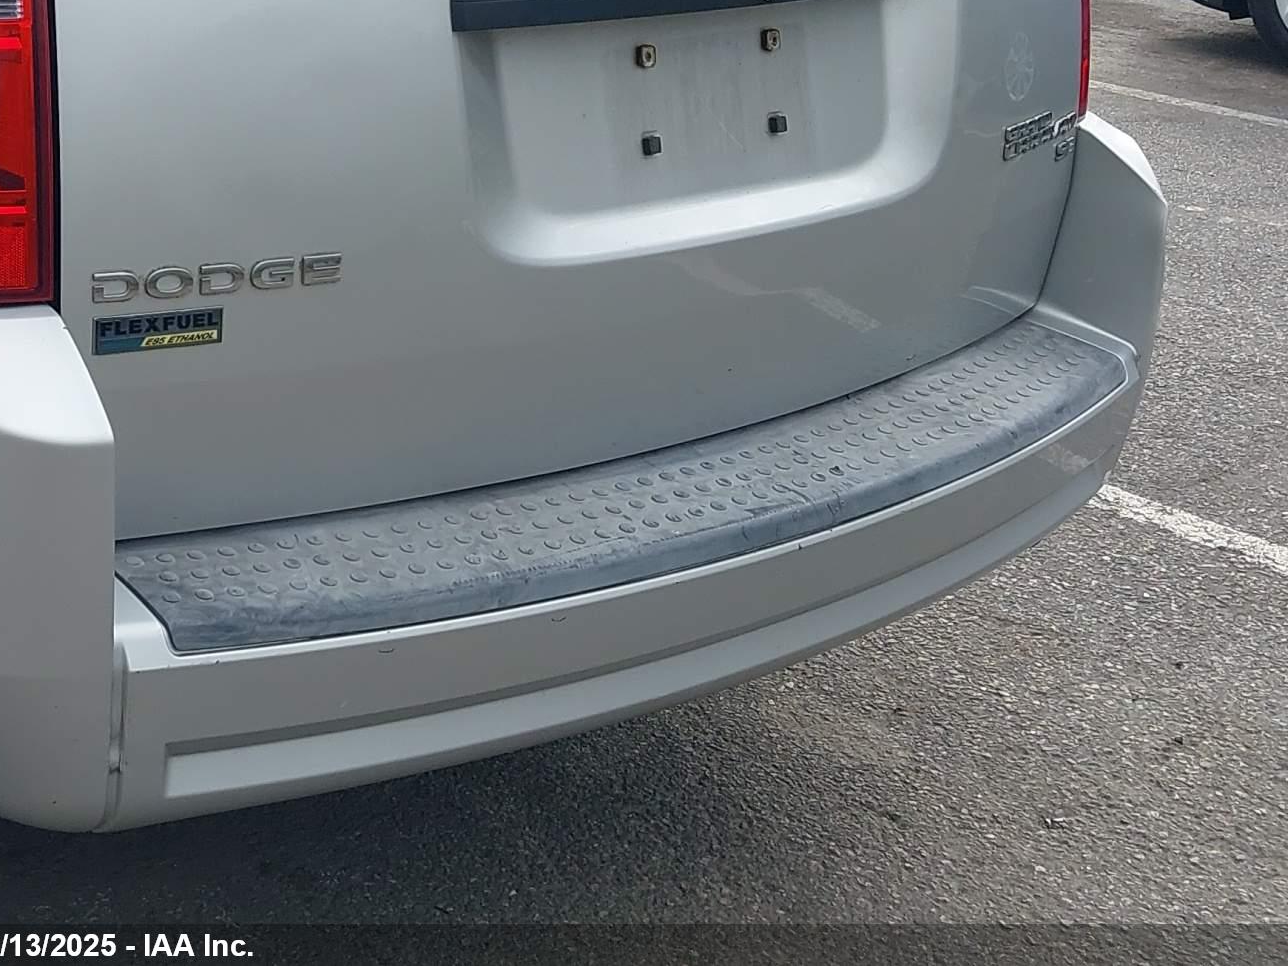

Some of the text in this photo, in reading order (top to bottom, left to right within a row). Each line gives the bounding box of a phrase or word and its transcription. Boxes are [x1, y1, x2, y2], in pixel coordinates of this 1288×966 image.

[91, 252, 342, 303] DODGE
[99, 312, 219, 337] FLEXFUEL
[167, 332, 215, 344] ETHANOL
